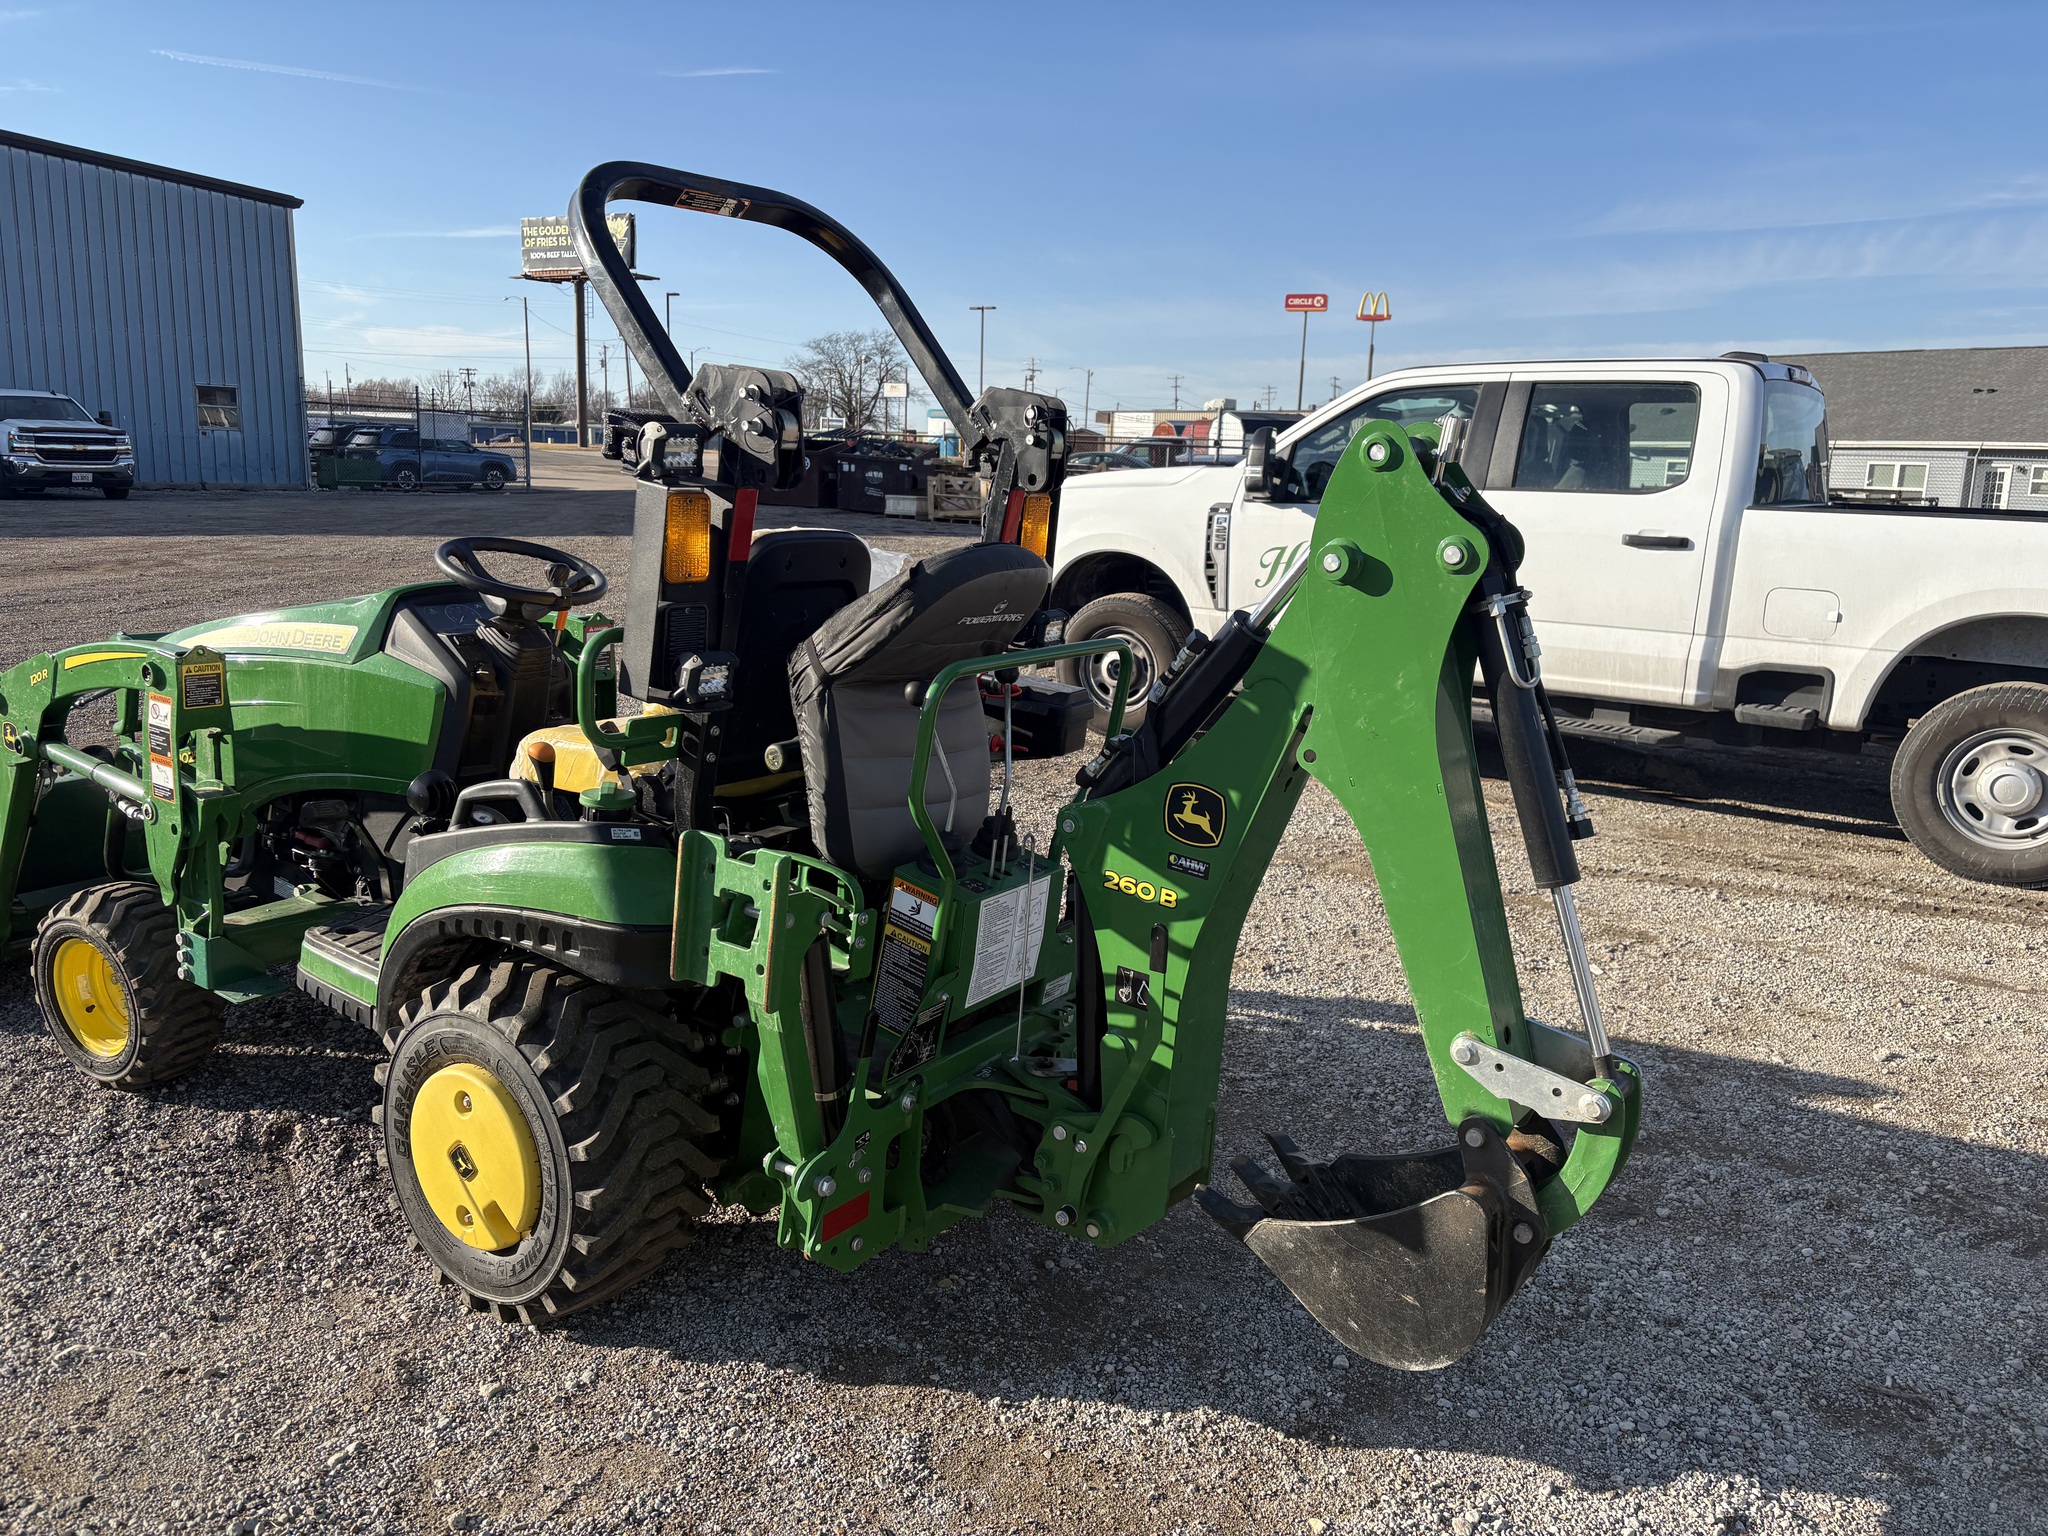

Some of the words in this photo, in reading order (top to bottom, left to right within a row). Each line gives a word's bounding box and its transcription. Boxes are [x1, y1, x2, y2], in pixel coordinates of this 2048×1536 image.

[522, 226, 538, 236] THE
[524, 238, 536, 247] OF
[537, 236, 558, 247] FRIES
[559, 236, 567, 246] IS
[547, 251, 560, 259] BEEF
[561, 250, 577, 258] TALLO
[1314, 296, 1324, 306] K
[957, 613, 1025, 625] POWERWORKS
[252, 630, 290, 645] JOHN
[292, 629, 343, 648] DEERE
[42, 669, 48, 679] R
[193, 664, 220, 673] CAUTION
[1178, 857, 1206, 872] AHW
[904, 885, 938, 905] WARNING
[1103, 870, 1156, 902] 260
[1158, 886, 1178, 909] B
[897, 934, 928, 953] CAUTION
[393, 1039, 440, 1159] CARLISLE
[507, 1236, 544, 1279] CHIEF
